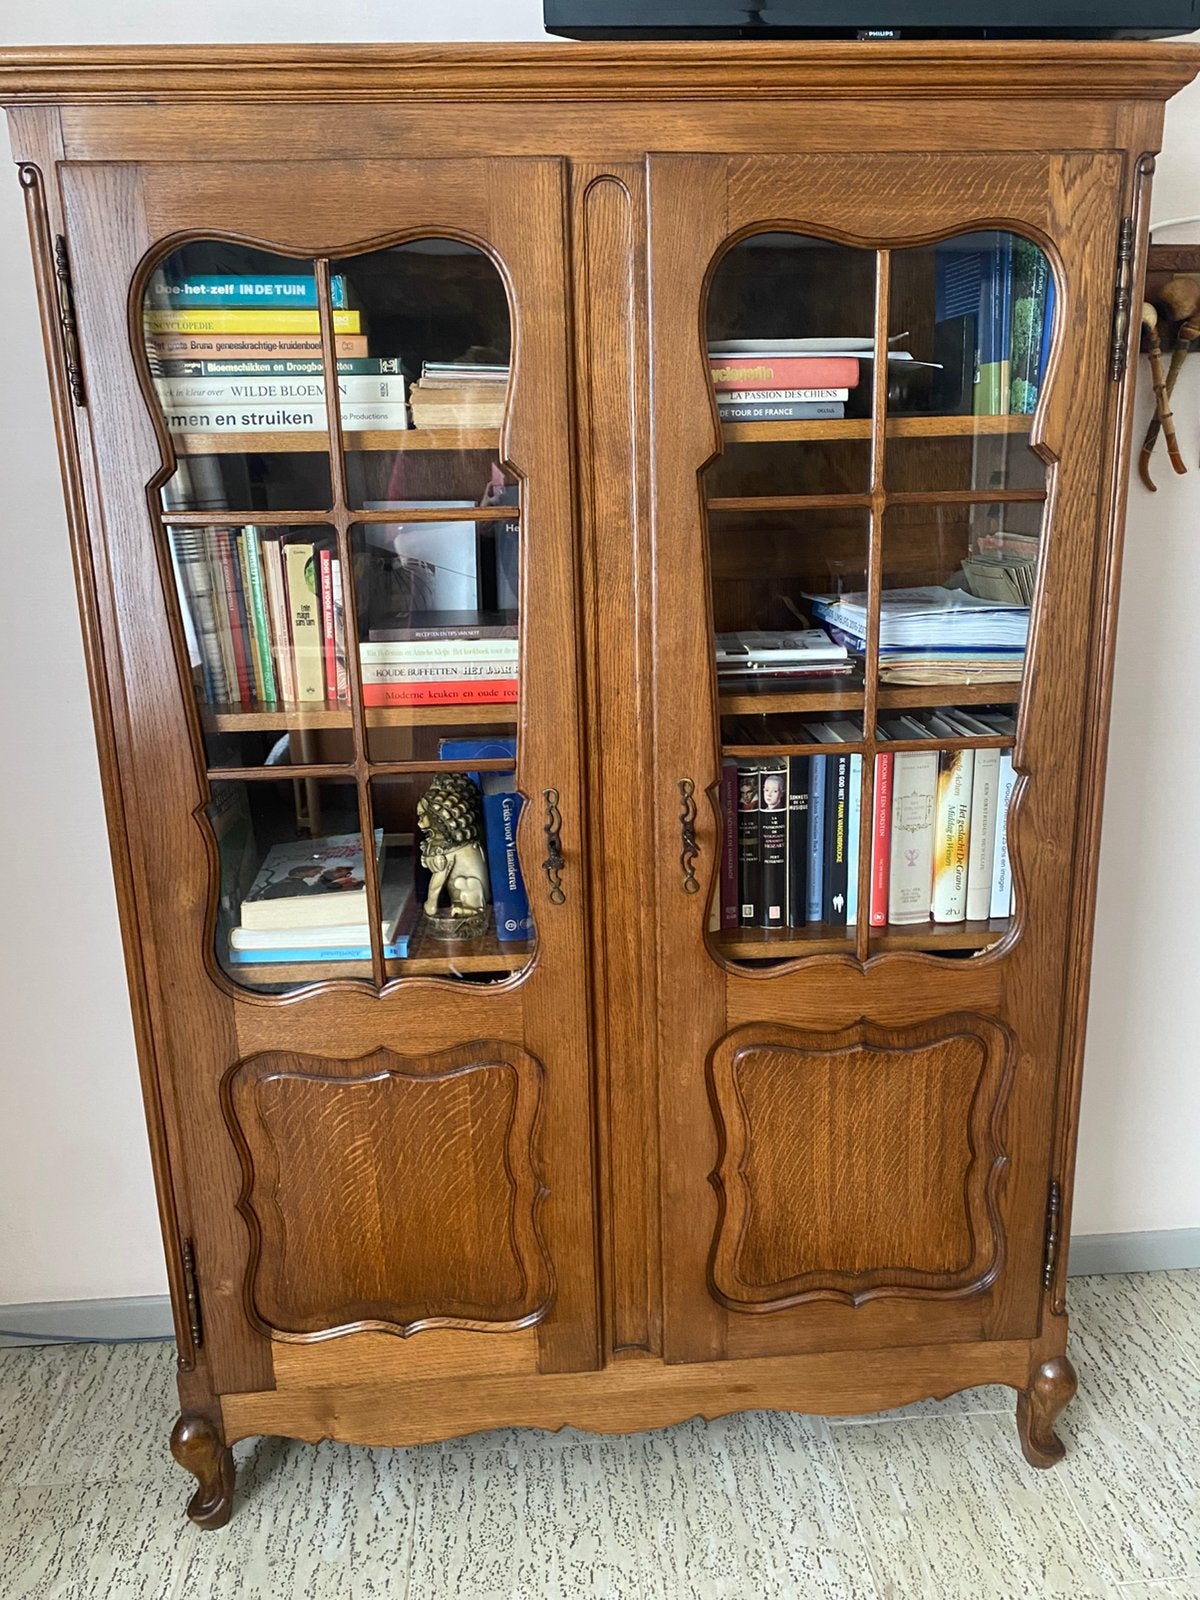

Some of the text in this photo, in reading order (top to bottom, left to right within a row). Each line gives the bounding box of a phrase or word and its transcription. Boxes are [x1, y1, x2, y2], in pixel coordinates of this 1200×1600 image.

[155, 284, 306, 295] Doe-het-zelf IN DE TUIN
[190, 341, 213, 350] Bruna
[207, 362, 270, 372] Bloemschikken
[185, 387, 205, 396] kleur
[231, 386, 277, 397] WILDE
[281, 385, 347, 396] BLOEMN
[744, 392, 782, 400] PASSION
[785, 391, 802, 399] DES
[804, 390, 837, 398] CHIENS
[215, 415, 236, 426] en
[241, 410, 313, 426] struiken
[731, 409, 752, 417] TOUR
[765, 408, 793, 416] FRANCE
[376, 668, 406, 678] KOUDE
[408, 666, 458, 676] BUFFETTEN
[385, 690, 424, 700] Moderne
[428, 690, 459, 698] keuken
[478, 689, 499, 697] oude
[959, 804, 968, 819] Het
[946, 804, 956, 834] Middag
[946, 834, 954, 842] in
[956, 820, 966, 852] geslacht
[502, 798, 518, 891] Gids voor Vlaanderen
